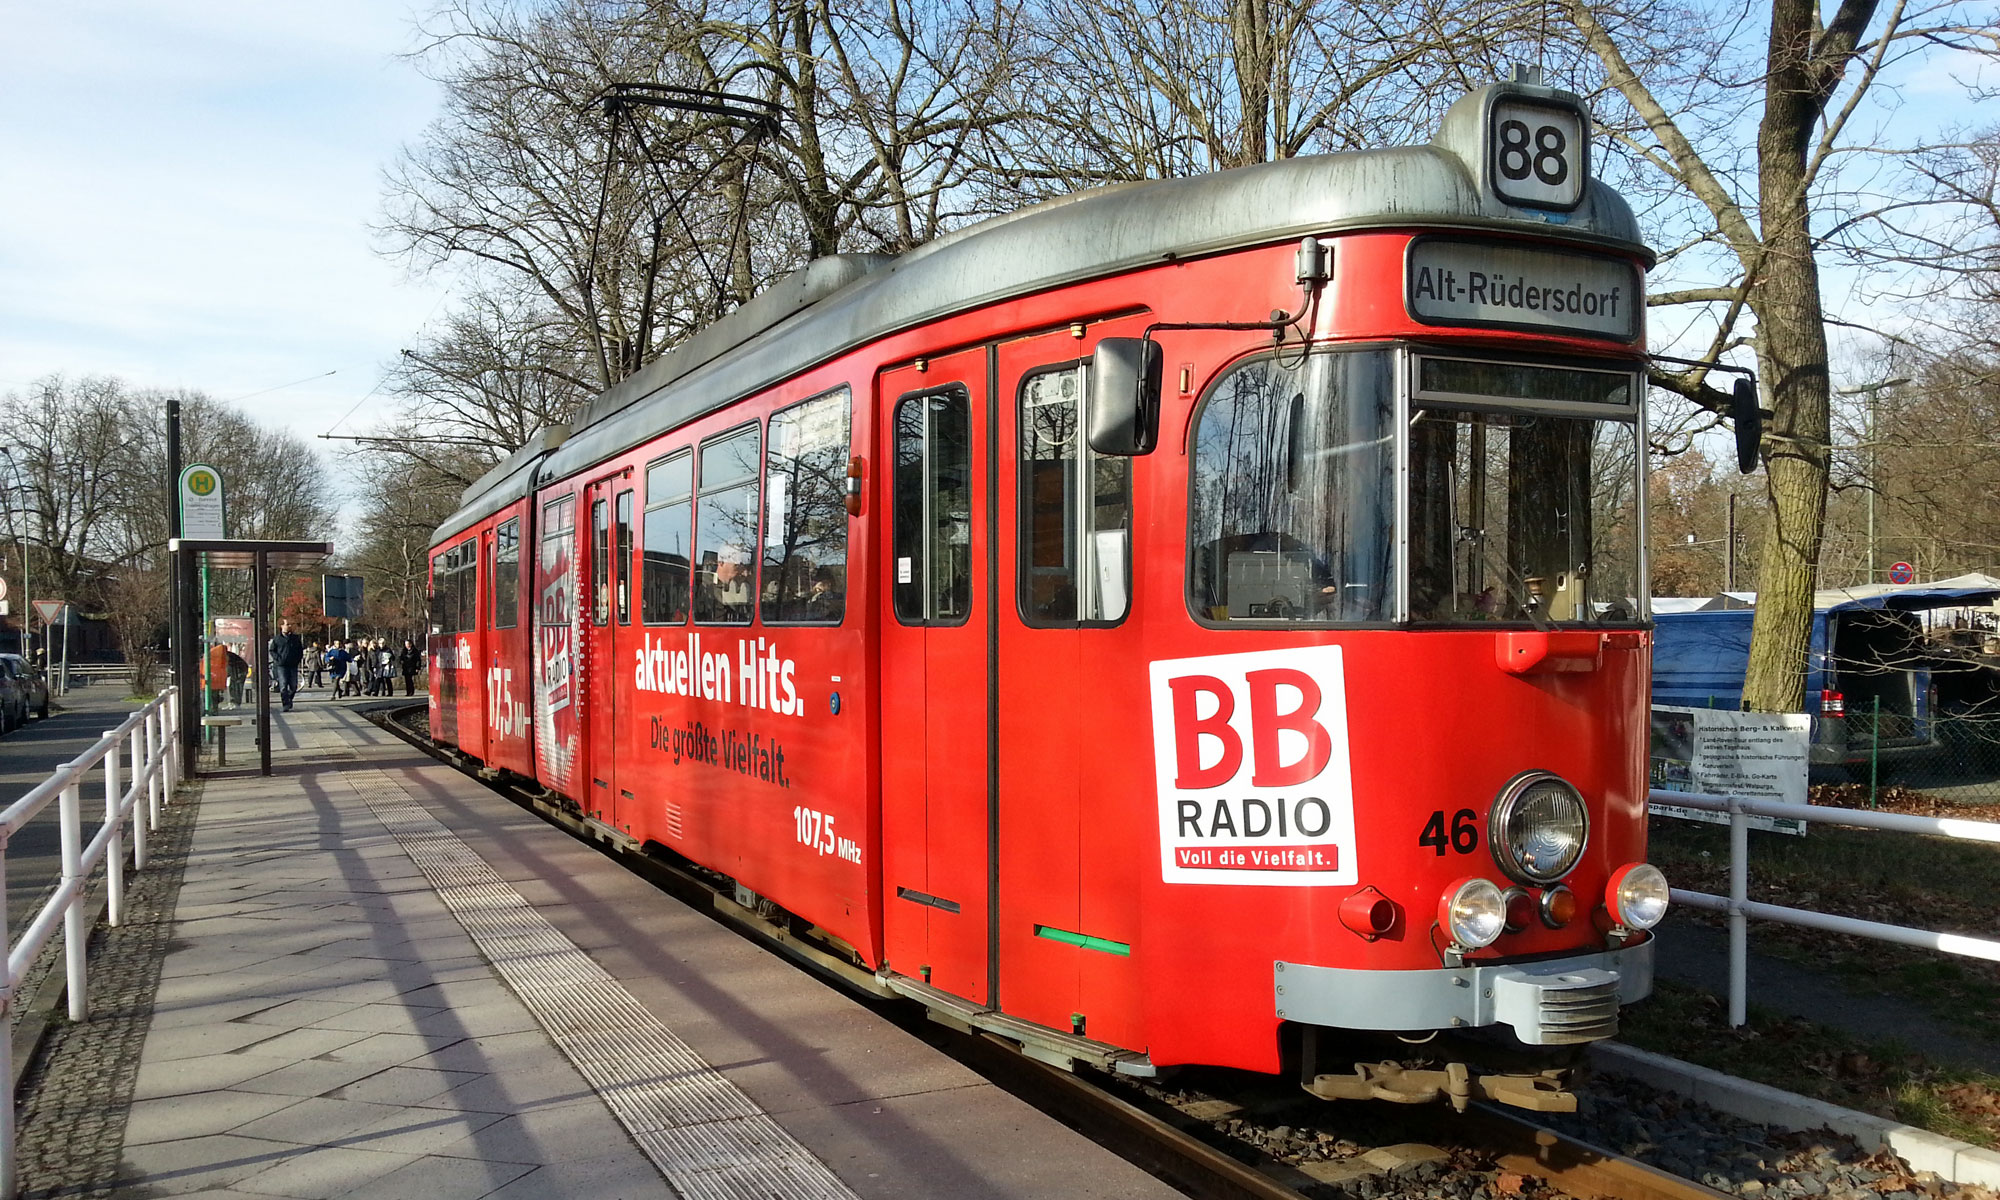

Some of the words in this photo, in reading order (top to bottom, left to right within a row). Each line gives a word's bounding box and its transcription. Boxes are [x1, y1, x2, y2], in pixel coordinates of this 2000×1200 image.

[1499, 120, 1568, 186] 88
[1415, 266, 1620, 317] Alt-Rüdersdorf
[547, 657, 567, 688] RADIO
[635, 632, 732, 703] aktuellen
[739, 636, 804, 717] Hits.
[651, 716, 669, 752] Die
[673, 721, 718, 766] größte
[722, 729, 790, 788] Vielfalt.
[1168, 668, 1332, 790] BB
[1740, 725, 1761, 733] Berg-
[794, 806, 835, 856] 107,5
[838, 837, 861, 864] MHz
[1177, 797, 1332, 838] RADIO
[1419, 808, 1478, 857] 46
[1180, 850, 1212, 866] Voll
[1219, 850, 1246, 866] die
[1251, 849, 1331, 867] Vielfalt.
